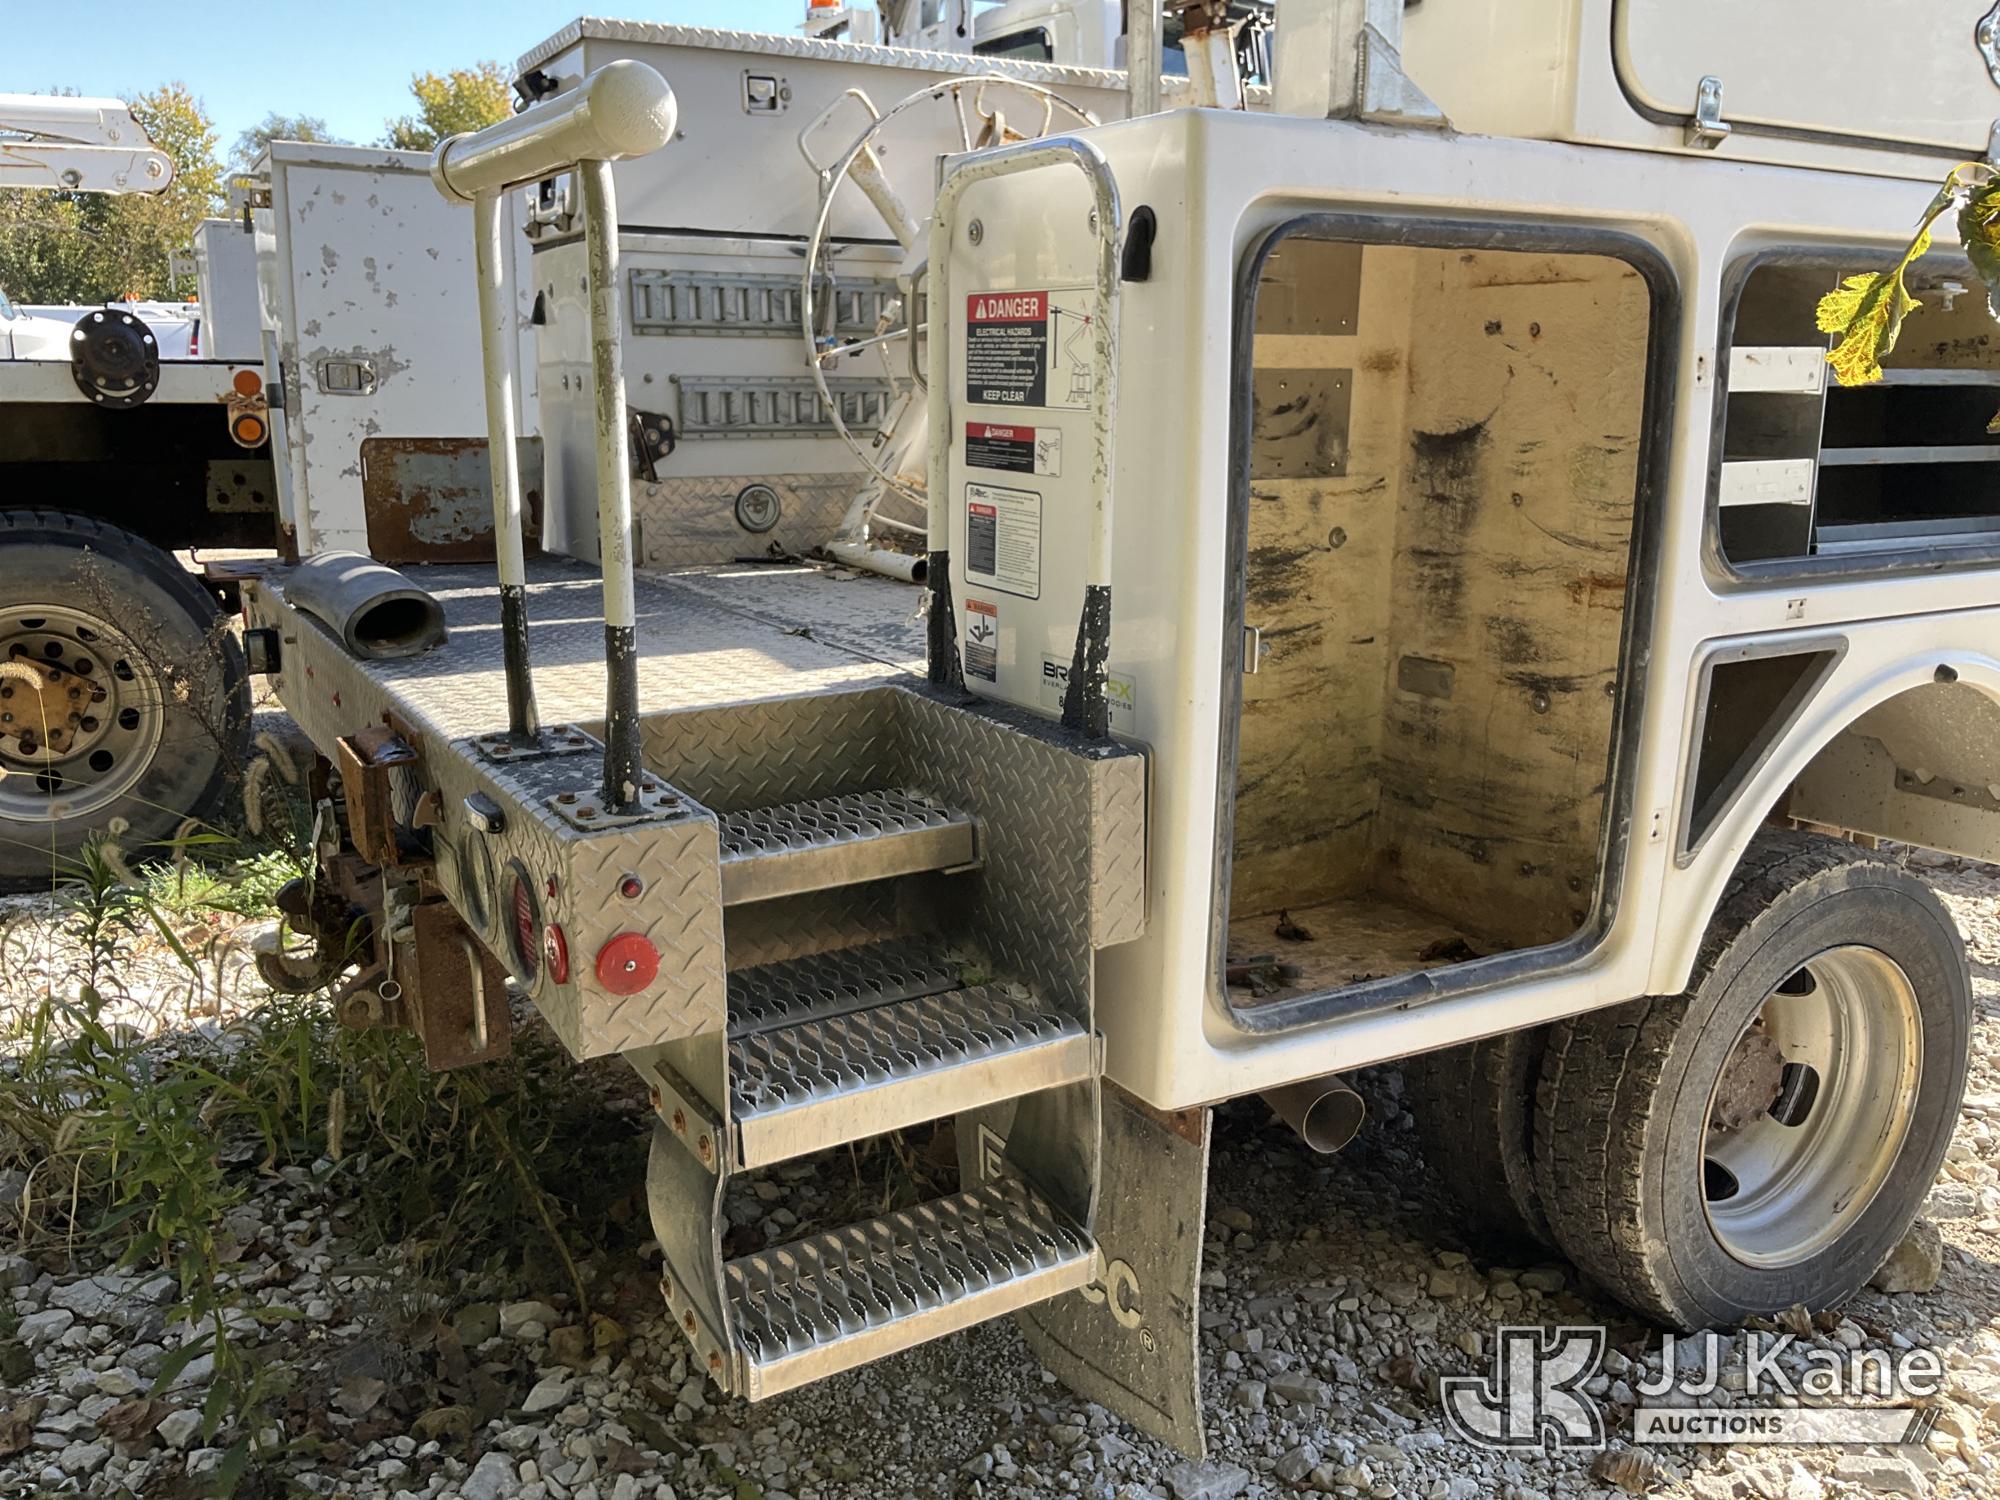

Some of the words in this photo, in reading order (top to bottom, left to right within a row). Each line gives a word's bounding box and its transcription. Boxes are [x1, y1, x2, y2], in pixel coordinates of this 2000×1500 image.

[988, 297, 1039, 319] DANGER
[976, 328, 1007, 337] ELECTRICAL
[1007, 327, 1032, 336] HAZARDS
[983, 390, 1001, 401] KEEP
[1001, 391, 1025, 402] CLEAR
[991, 428, 1014, 438] DANGER
